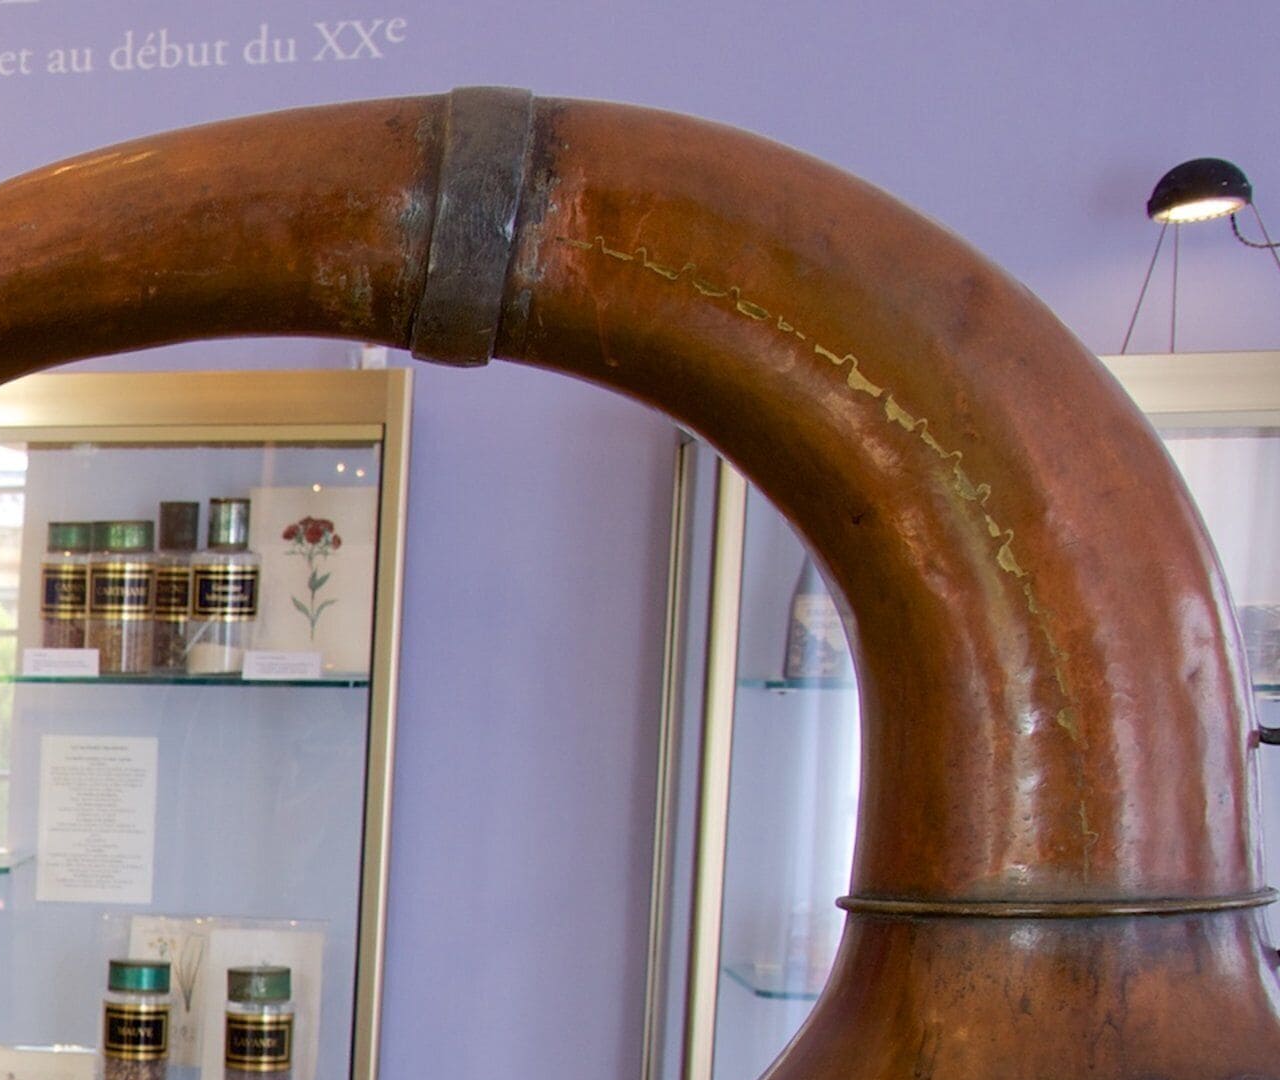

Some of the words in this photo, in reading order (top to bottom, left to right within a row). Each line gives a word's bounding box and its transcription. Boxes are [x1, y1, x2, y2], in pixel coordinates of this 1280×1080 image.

[46, 47, 94, 74] au
[109, 28, 230, 71] début
[243, 23, 298, 65] du
